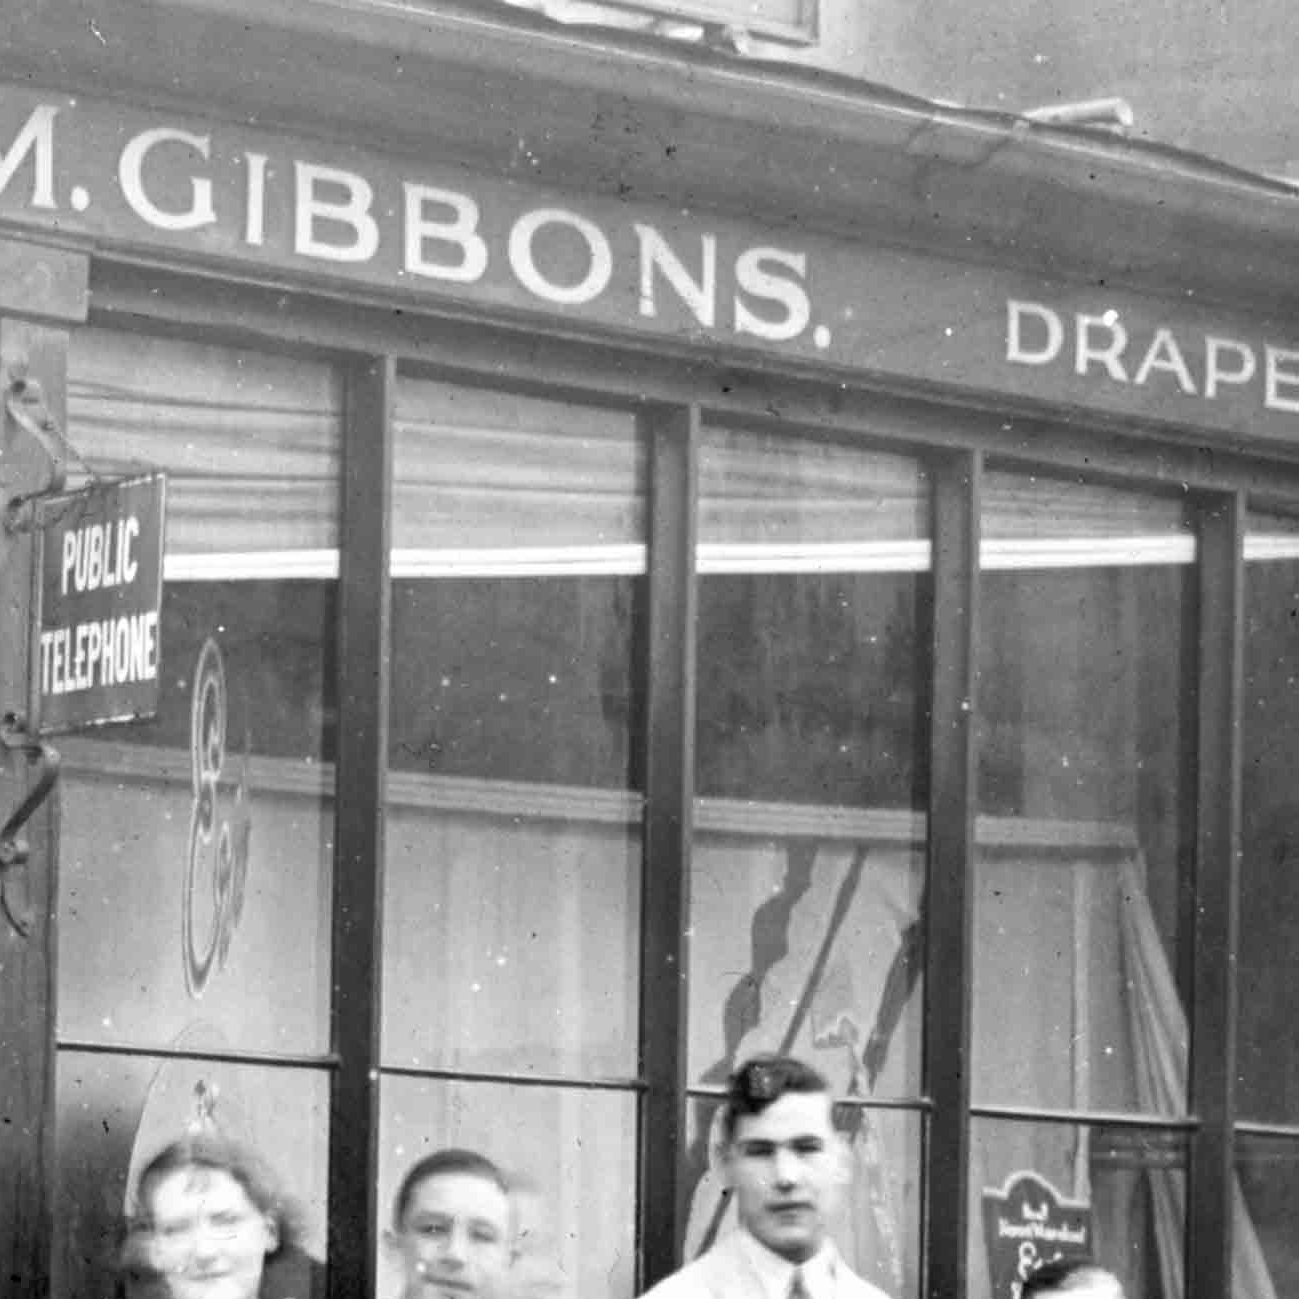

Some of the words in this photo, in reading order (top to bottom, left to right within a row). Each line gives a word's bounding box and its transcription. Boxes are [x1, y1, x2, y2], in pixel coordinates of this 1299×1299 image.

[116, 126, 833, 350] GIBBONS.
[61, 514, 141, 596] PUBLIC
[39, 610, 158, 696] TELEPHONE
